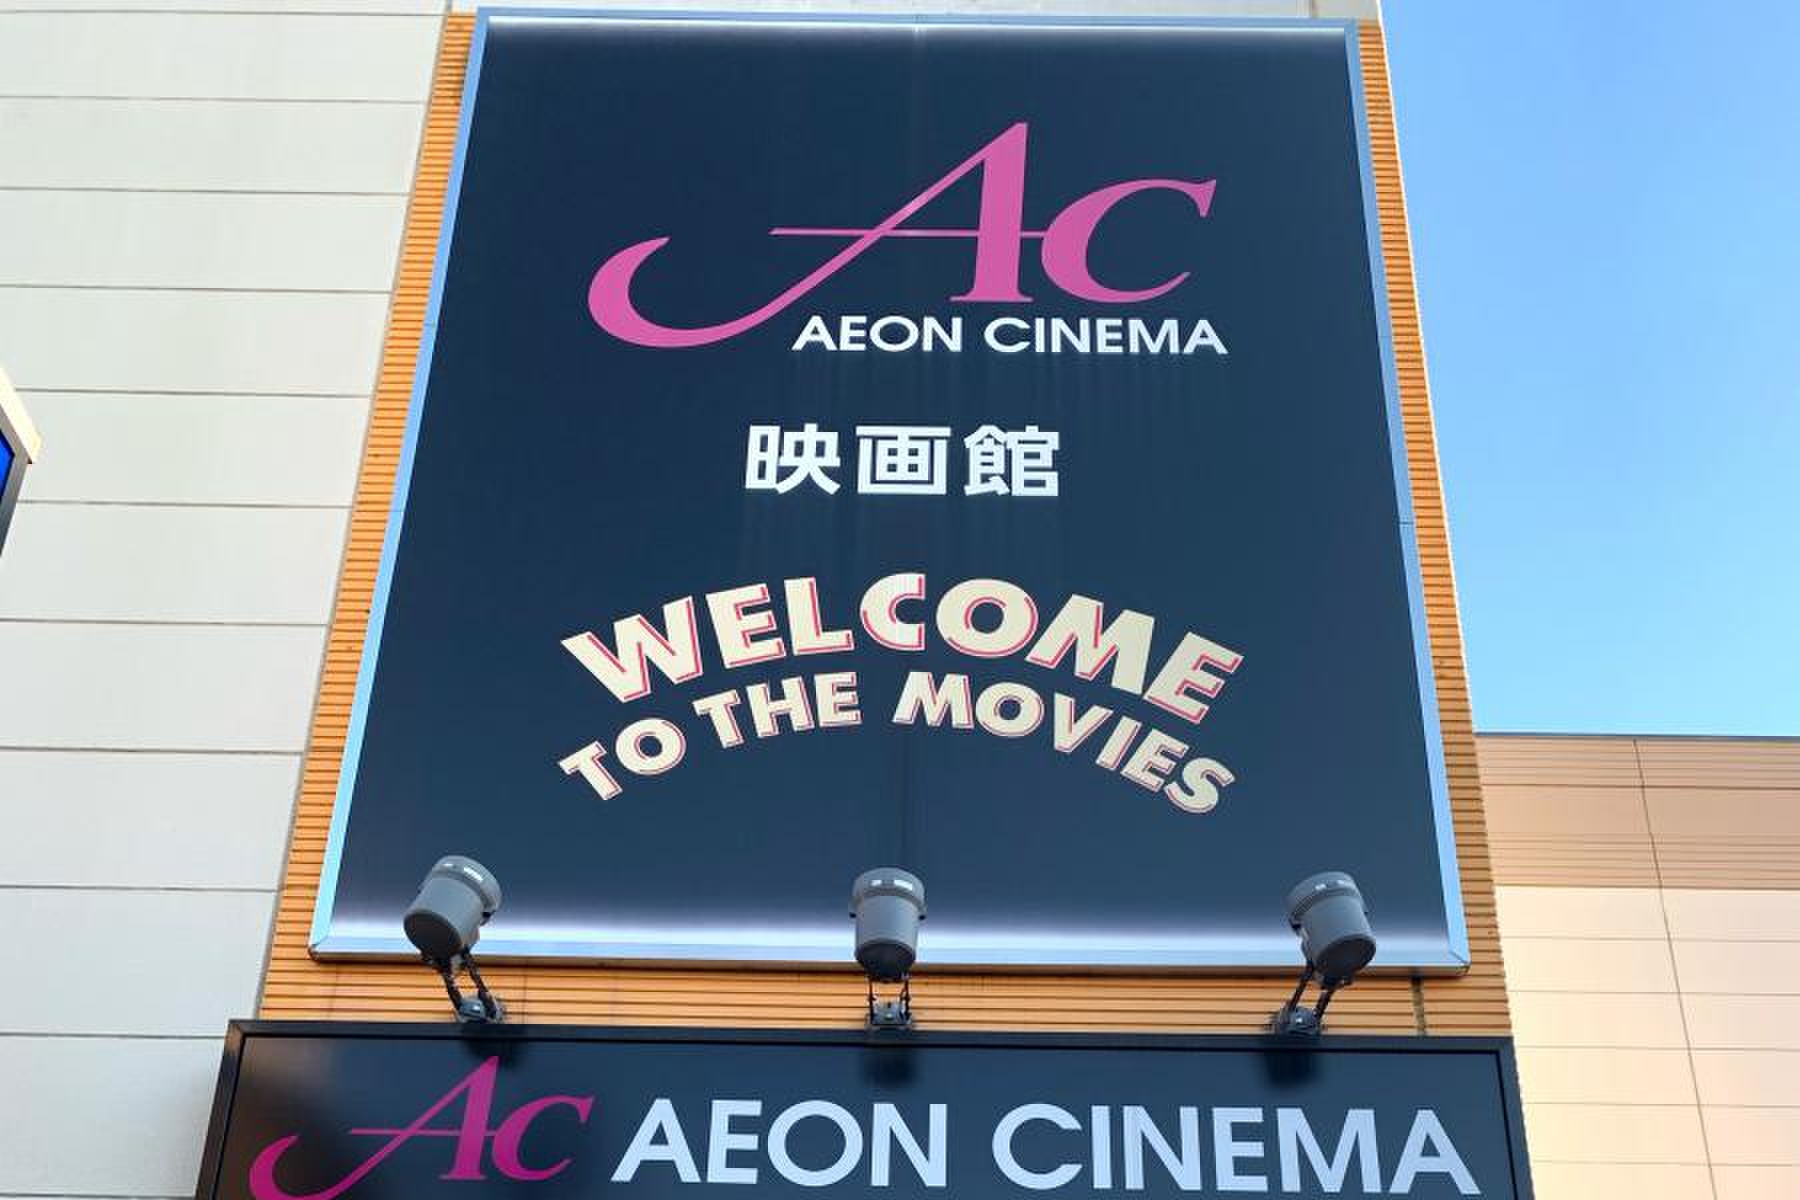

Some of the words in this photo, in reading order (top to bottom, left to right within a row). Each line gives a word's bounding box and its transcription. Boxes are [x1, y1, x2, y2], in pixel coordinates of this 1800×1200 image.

[791, 315, 963, 352] AEON
[983, 316, 1229, 355] CINEMA
[744, 423, 1060, 497] 映画館
[561, 572, 1243, 724] WELCOME
[558, 717, 687, 801] TO
[692, 670, 863, 749] THE
[893, 670, 1236, 813] MOVIES
[610, 1097, 949, 1188] AEON
[991, 1102, 1481, 1197] CINEMA
